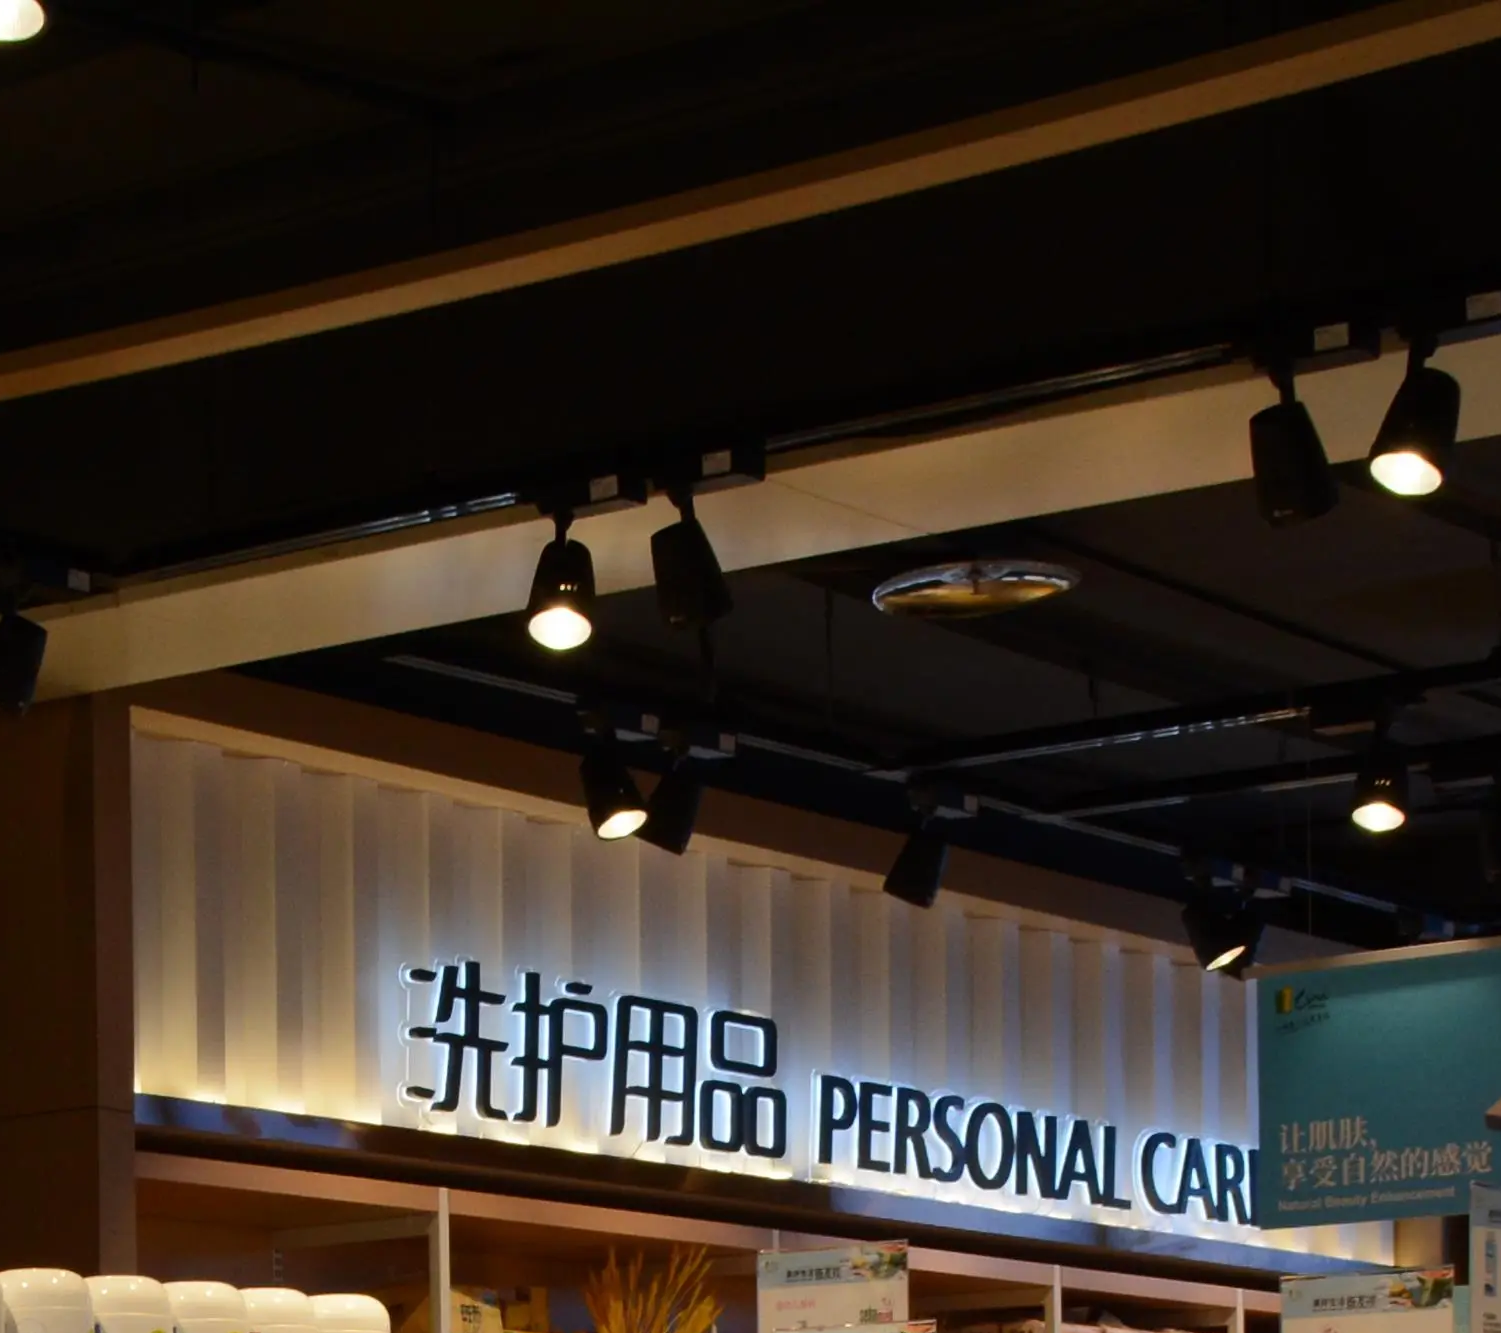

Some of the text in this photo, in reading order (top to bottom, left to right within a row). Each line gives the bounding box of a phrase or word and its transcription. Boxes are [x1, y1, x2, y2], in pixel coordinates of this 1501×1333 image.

[405, 961, 786, 1158] 洗护用品
[820, 1075, 1130, 1209] PERSONAL
[1281, 1142, 1493, 1190] 享受自然的感觉
